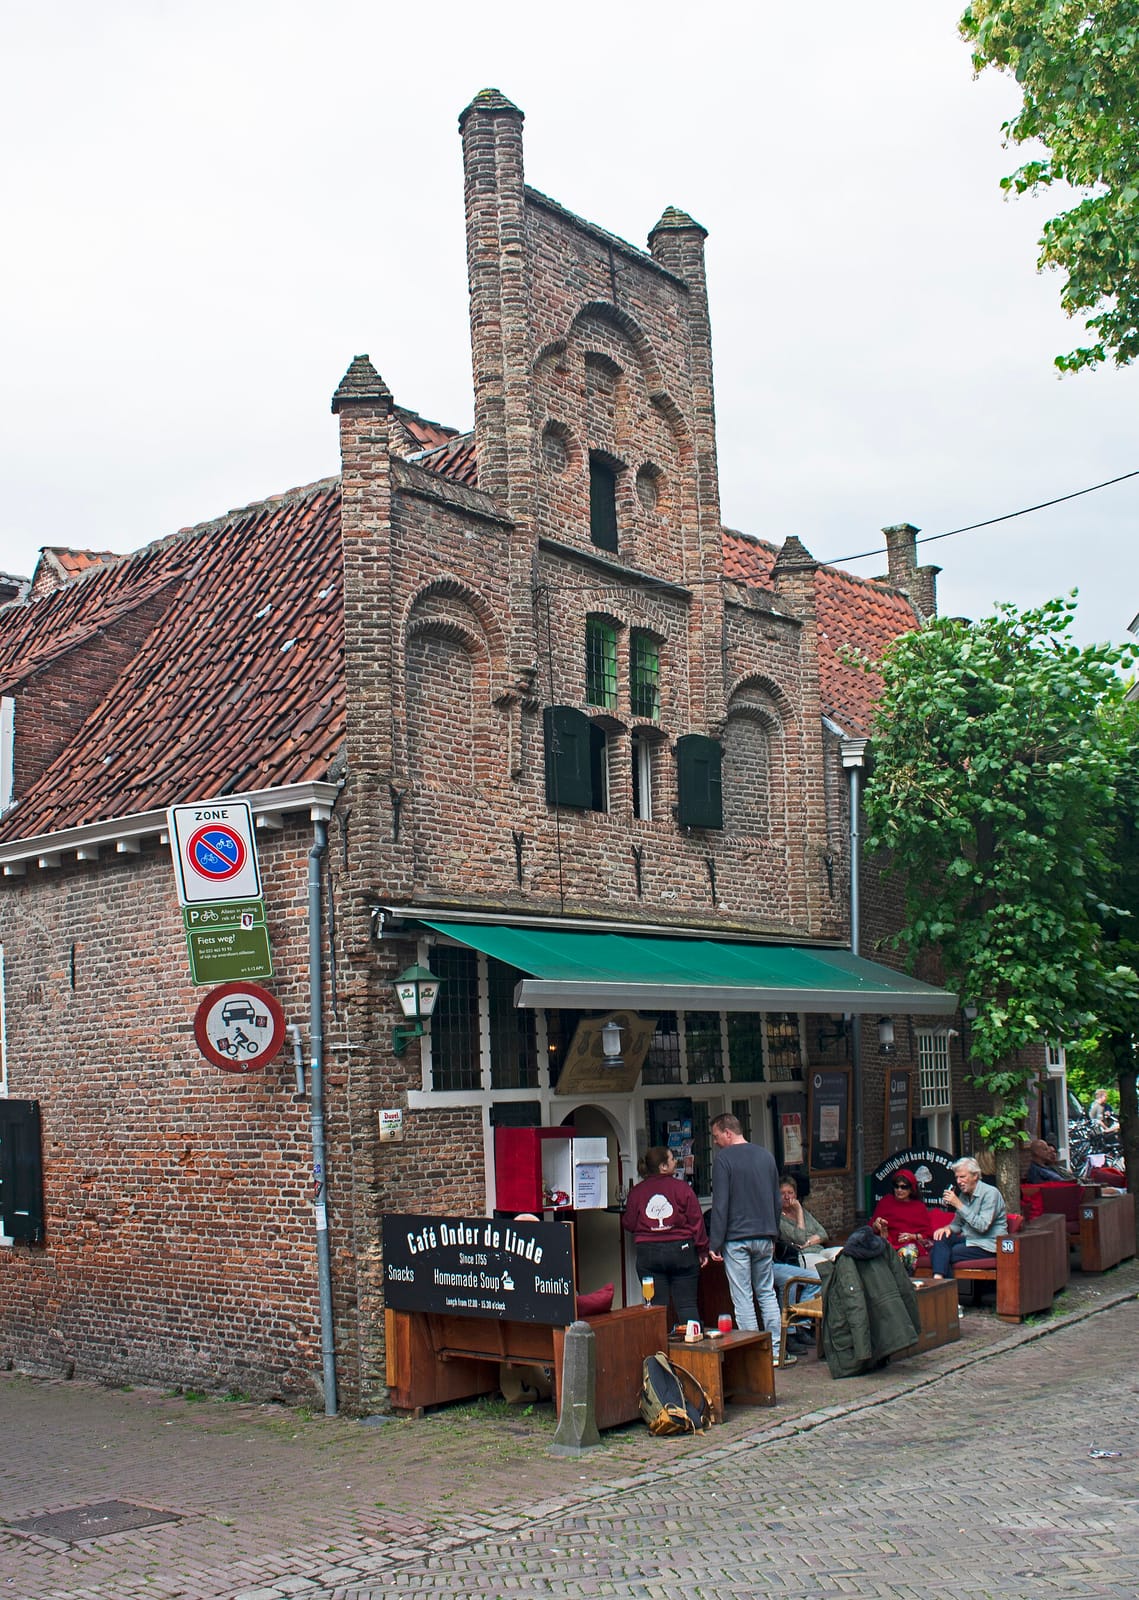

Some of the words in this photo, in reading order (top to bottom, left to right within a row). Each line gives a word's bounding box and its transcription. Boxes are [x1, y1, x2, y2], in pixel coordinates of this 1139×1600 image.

[194, 810, 229, 821] ZONE
[190, 911, 199, 923] P
[197, 937, 216, 945] Fiets
[384, 1112, 399, 1120] Duvel
[875, 1152, 910, 1181] Gezelligheid
[926, 1151, 935, 1163] bij
[935, 1155, 947, 1165] ons
[407, 1227, 437, 1254] Café
[440, 1222, 479, 1246] Onder
[484, 1224, 500, 1248] de
[505, 1228, 543, 1264] Linde
[459, 1252, 474, 1264] Since
[475, 1253, 487, 1265] 1755
[388, 1264, 414, 1282] Snacks
[434, 1268, 478, 1288] Homemade
[480, 1271, 500, 1292] Soup
[534, 1276, 569, 1295] Panini's
